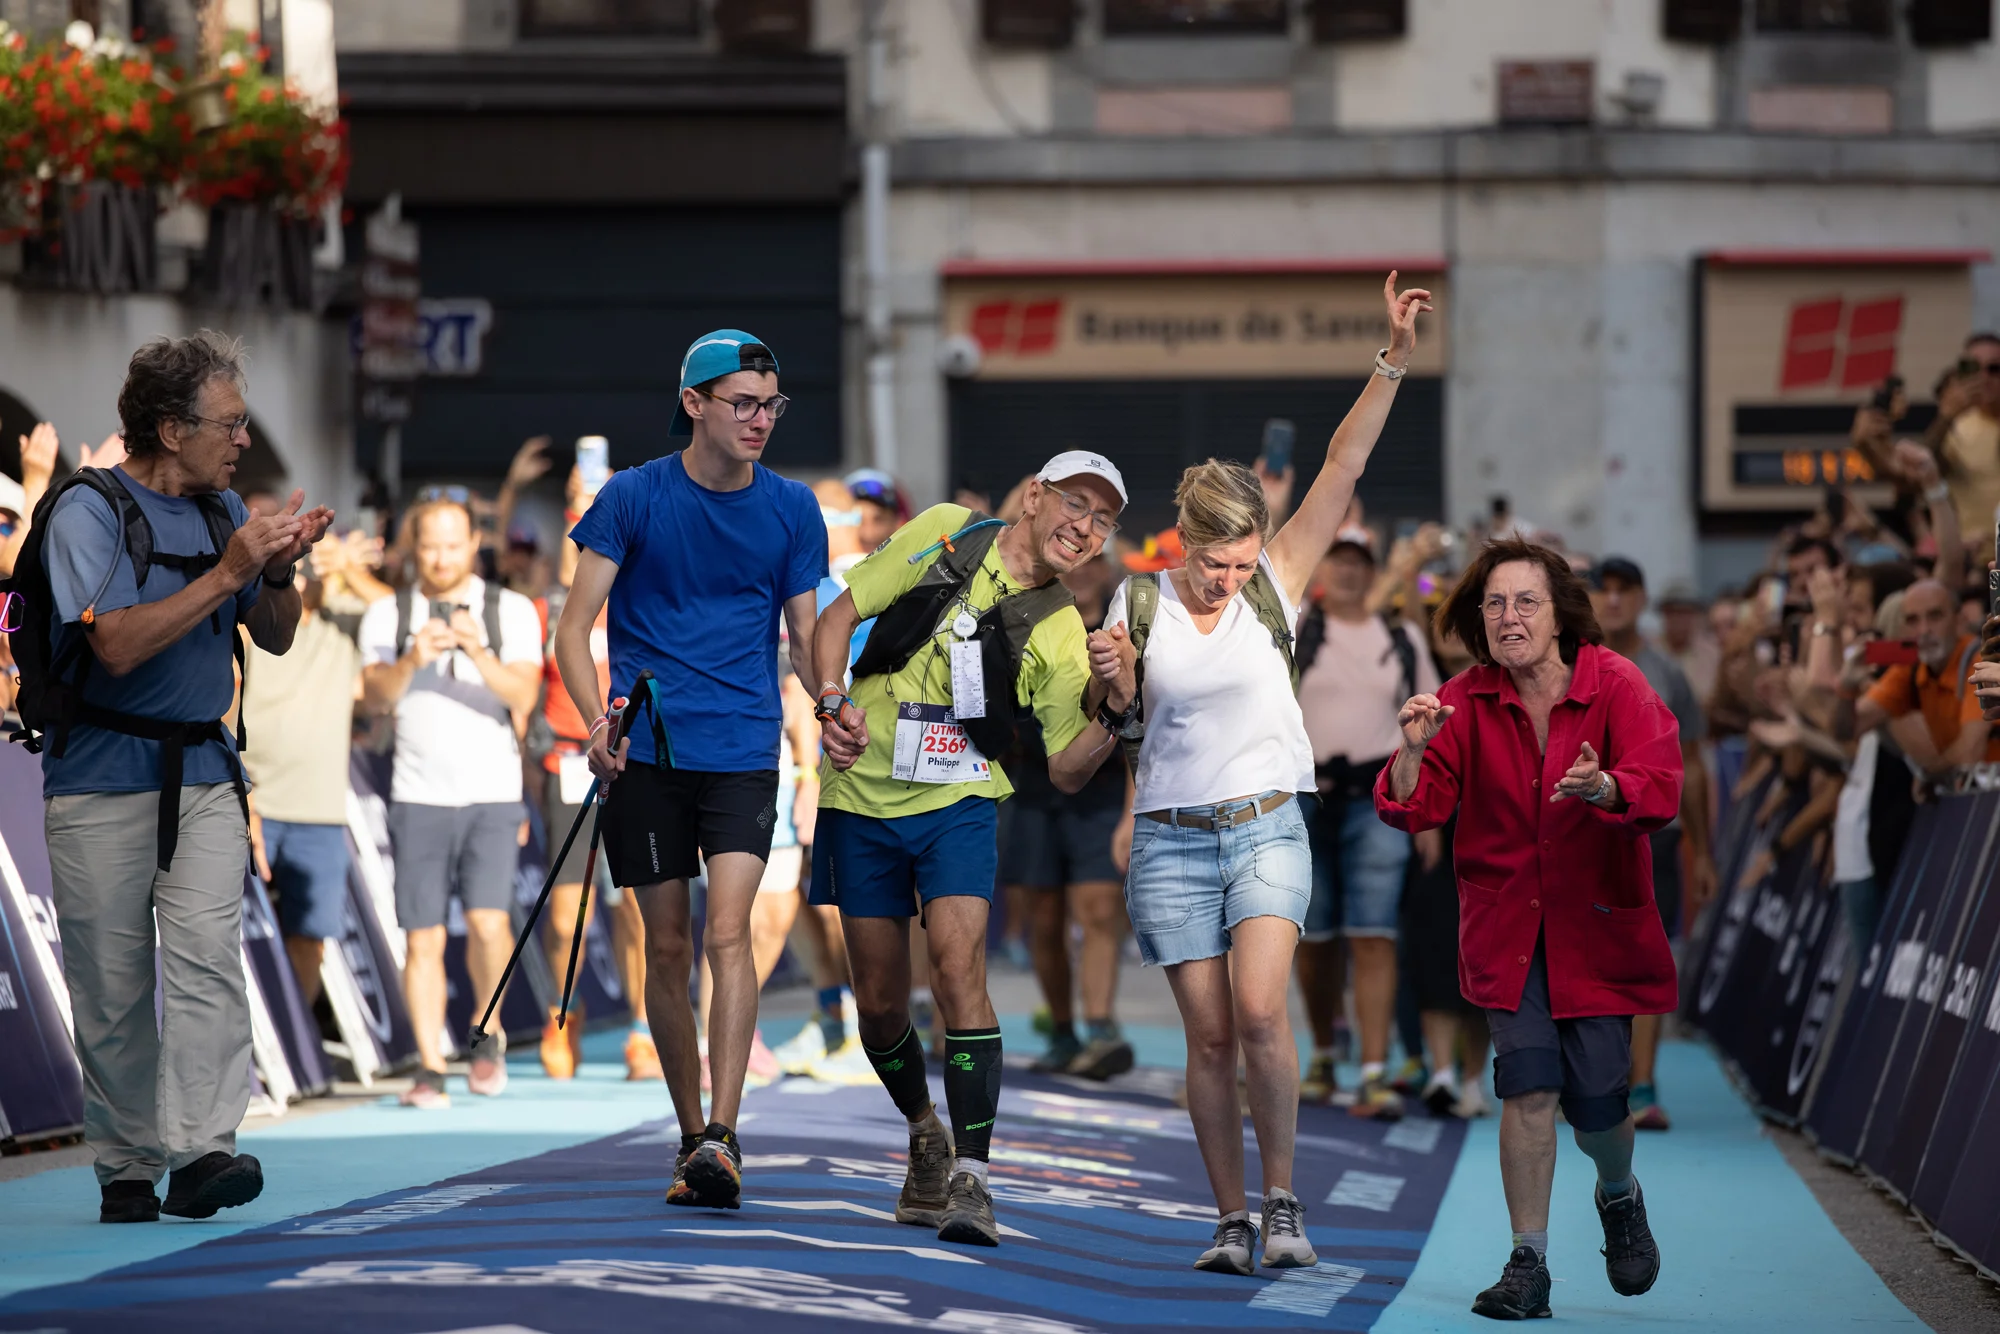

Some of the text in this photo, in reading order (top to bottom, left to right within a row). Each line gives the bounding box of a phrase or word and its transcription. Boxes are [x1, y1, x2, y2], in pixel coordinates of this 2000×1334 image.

[931, 724, 964, 736] UTMB
[923, 736, 968, 753] 2569
[928, 757, 960, 768] Philippe
[648, 832, 660, 873] SALOMON
